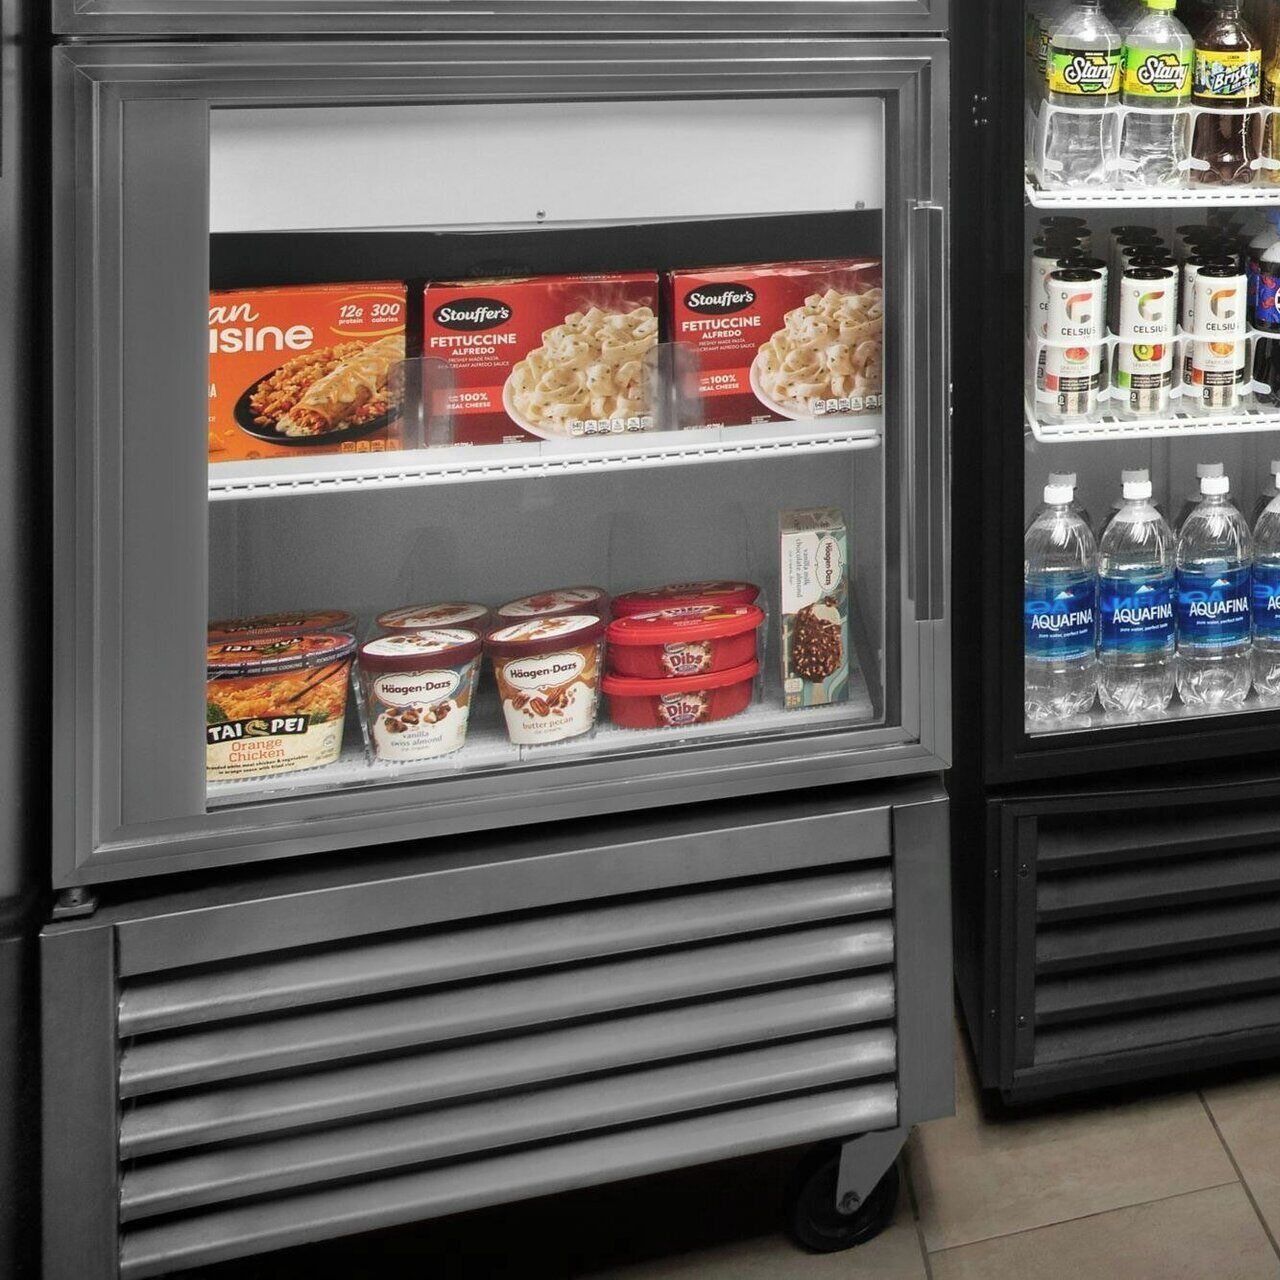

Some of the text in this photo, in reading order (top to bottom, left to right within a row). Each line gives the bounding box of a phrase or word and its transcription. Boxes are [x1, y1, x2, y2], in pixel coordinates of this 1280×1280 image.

[1065, 57, 1116, 88] Starry
[1138, 58, 1189, 88] Starry
[688, 291, 755, 309] Stouffer's
[209, 302, 259, 326] an
[371, 303, 400, 316] 300
[437, 306, 509, 324] Stouffer's
[339, 315, 398, 325] protein calories
[682, 316, 761, 332] FETTUCCINE
[209, 325, 314, 354] isine
[430, 334, 516, 348] FETTUCCINE
[702, 330, 742, 339] ALFREDO
[452, 346, 495, 355] ALFREDO
[709, 374, 736, 384] 100%
[715, 382, 739, 390] CHEESE
[459, 392, 488, 402] 100%
[464, 401, 491, 409] CHEESE
[1113, 603, 1173, 625] AQUAFINA
[1189, 597, 1249, 618] AQUAFINA
[1031, 609, 1093, 631] AQUAFINA
[670, 651, 702, 666] Dibs
[510, 659, 577, 680] Häagen-Dazs
[381, 681, 450, 694] Häagen-Dazs
[667, 702, 700, 716] Dibs
[208, 718, 304, 741] TAI PEI
[231, 737, 283, 751] Orange
[229, 748, 284, 762] Chicken
